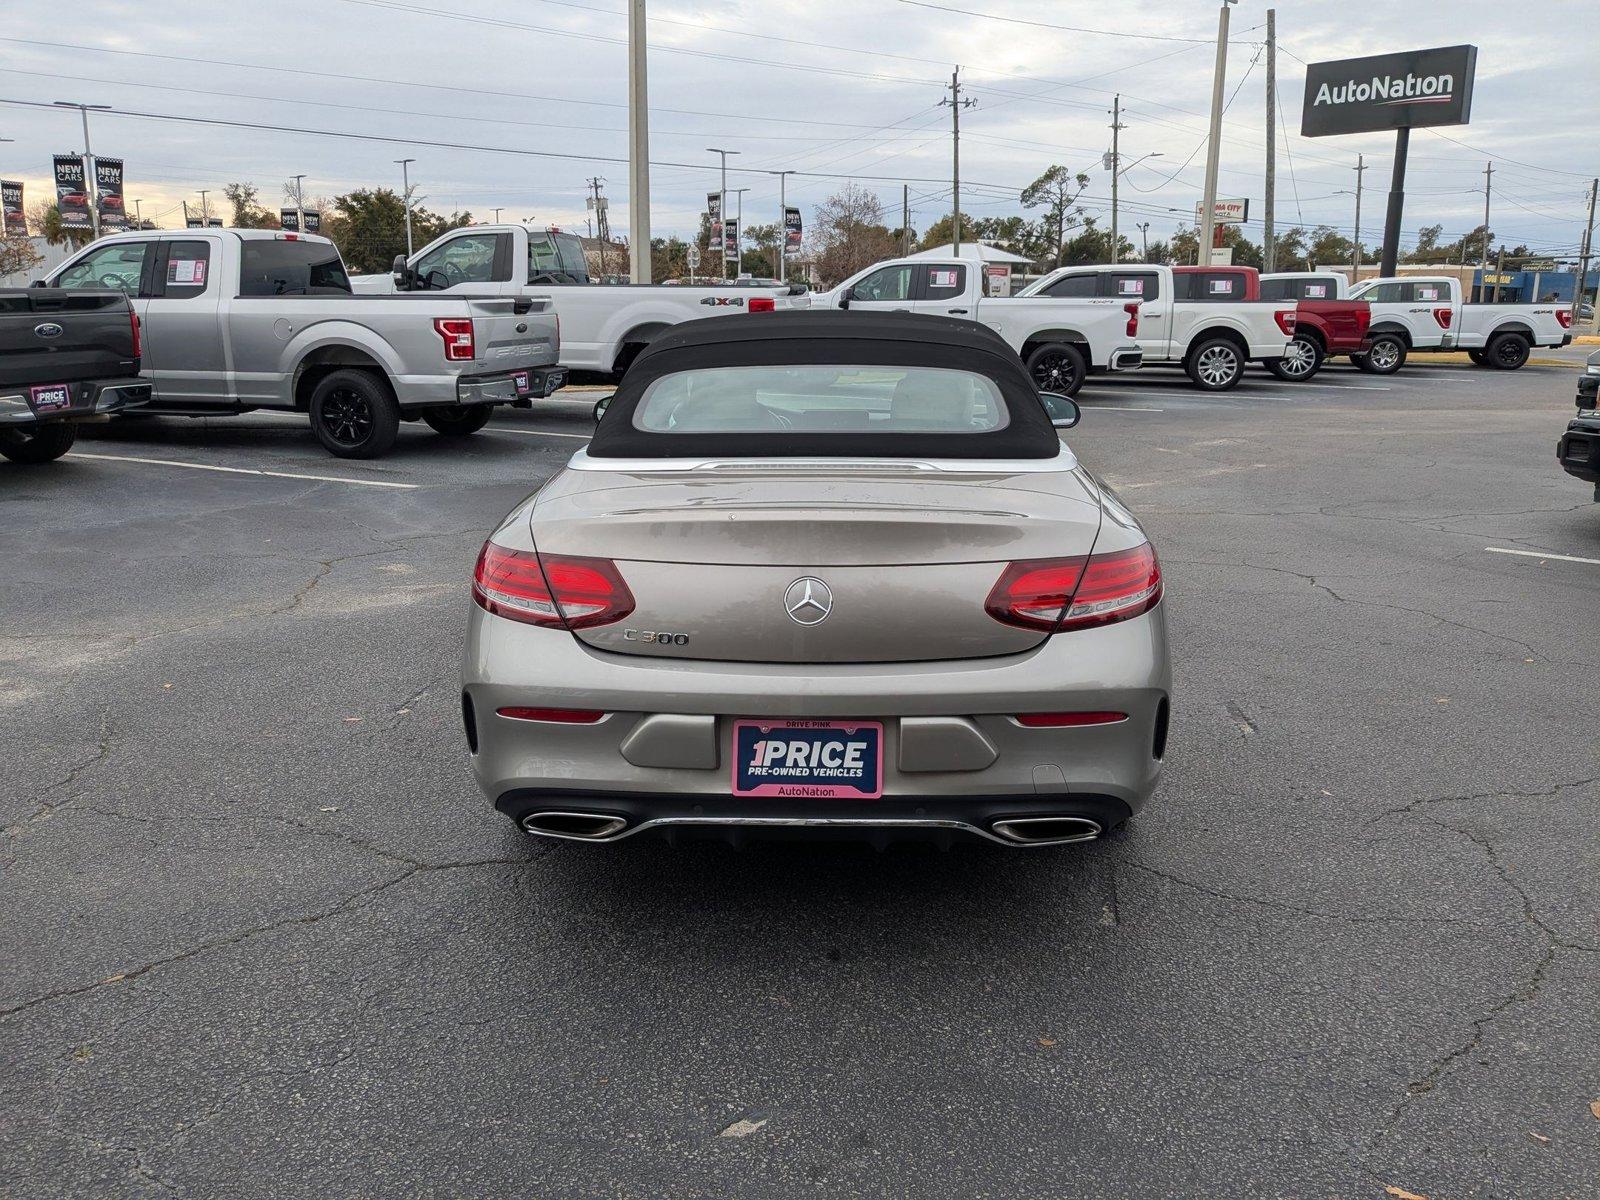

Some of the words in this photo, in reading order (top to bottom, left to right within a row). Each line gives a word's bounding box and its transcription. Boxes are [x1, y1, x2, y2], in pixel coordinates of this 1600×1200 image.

[1313, 73, 1454, 106] AutoNation
[57, 164, 82, 174] NEW
[97, 166, 121, 177] NEW
[57, 173, 83, 182] CARS
[98, 175, 121, 185] CARS
[3, 188, 21, 196] NEW
[709, 200, 720, 208] NEW
[1227, 204, 1242, 213] CITY
[282, 214, 297, 222] NEW
[748, 767, 810, 777] PRE-OWNED
[813, 768, 863, 777] VEHICLES
[777, 786, 835, 797] AutoNation
